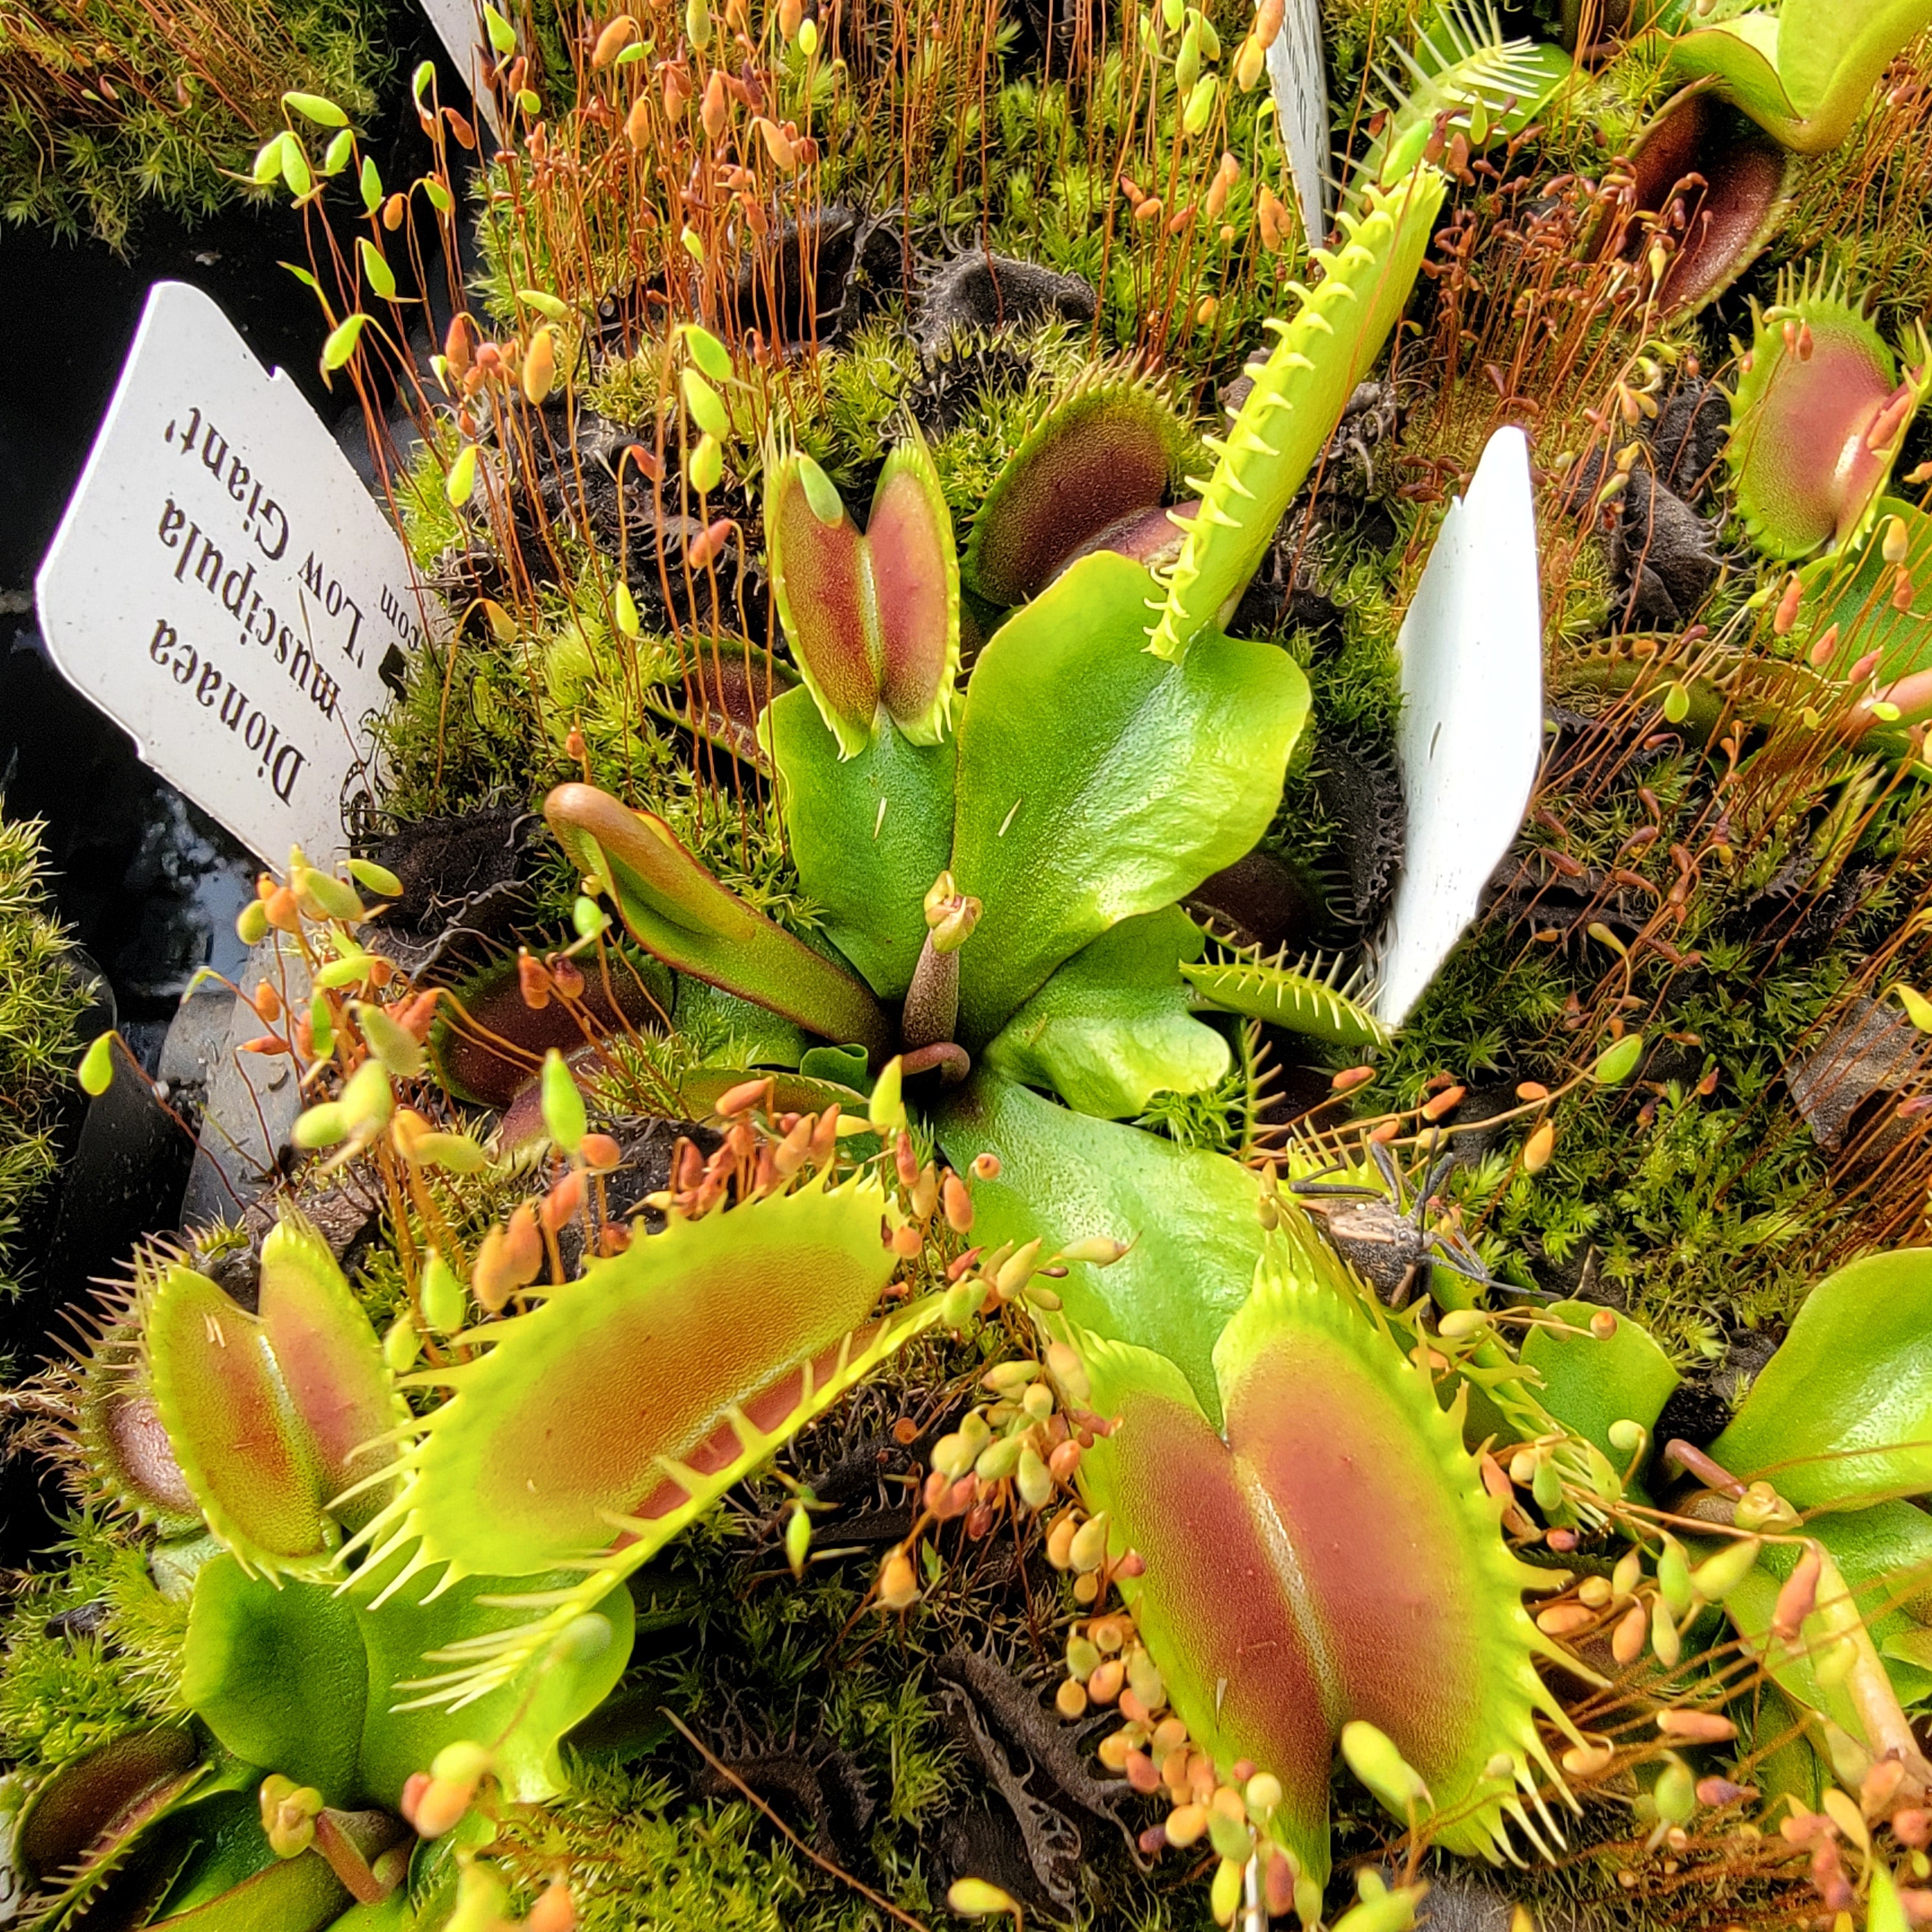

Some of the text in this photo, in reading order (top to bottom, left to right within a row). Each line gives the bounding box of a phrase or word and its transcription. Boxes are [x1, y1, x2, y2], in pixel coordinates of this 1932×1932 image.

[159, 498, 342, 721] muscipula
[165, 407, 365, 669] 'Low Giant'
[149, 619, 307, 807] Dionaea
